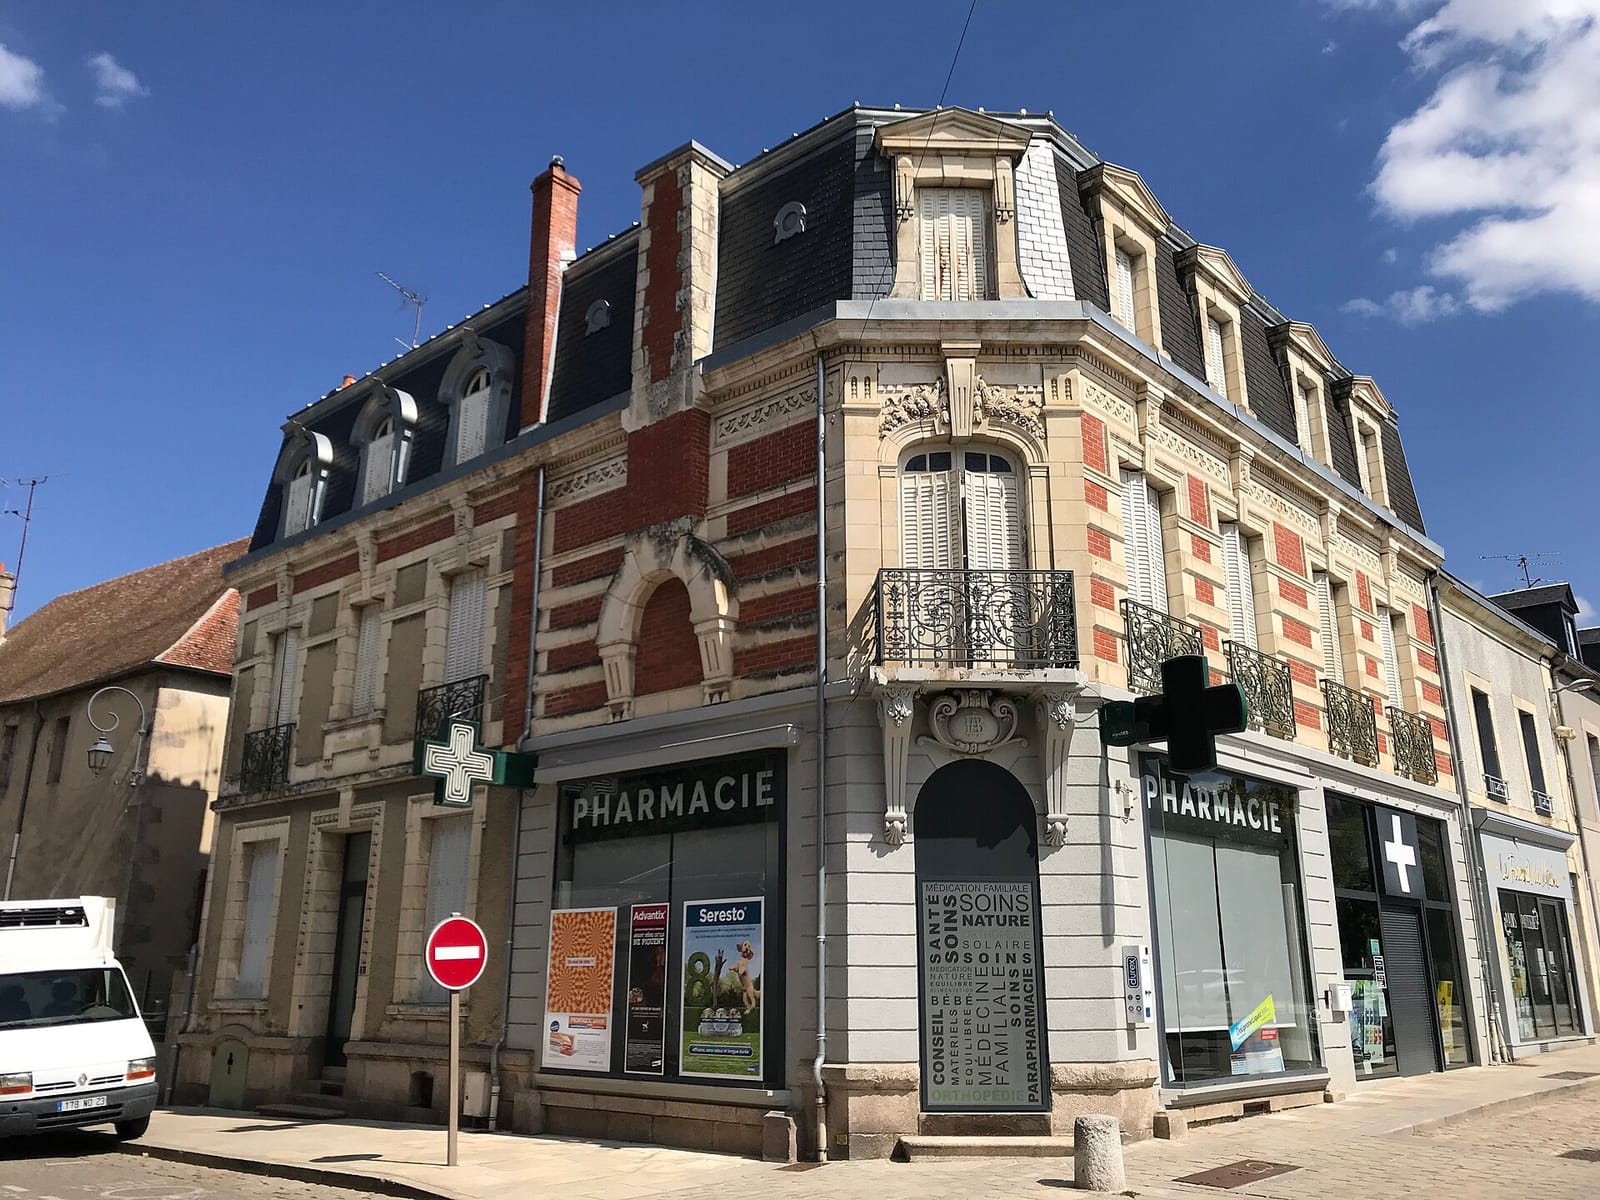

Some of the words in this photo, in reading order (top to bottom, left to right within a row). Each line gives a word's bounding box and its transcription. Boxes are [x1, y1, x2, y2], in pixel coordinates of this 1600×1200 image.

[573, 770, 774, 829] PHARMACIE
[1144, 774, 1281, 833] PHARMACIE
[633, 910, 666, 920] Advantix
[699, 907, 745, 922] Seresto
[960, 894, 1029, 912] SOINS
[984, 884, 1028, 892] FAMILIALE
[926, 895, 941, 964] SANTÉ
[943, 895, 959, 964] SOINS
[962, 914, 1030, 927] NATURE
[962, 941, 1030, 949] SOLAIRE
[963, 953, 1032, 964] SOINS
[1128, 958, 1137, 986] durex
[931, 993, 973, 1006] BÉBÉ
[974, 966, 992, 1085] MÉDECINE
[992, 966, 1009, 1085] FAMILIALE
[1009, 968, 1021, 1027] SOINS
[931, 1009, 945, 1085] CONSEIL
[949, 1009, 960, 1086] MATÉRIELS
[963, 1009, 974, 1086] EQUILIBRE
[1023, 968, 1039, 1103] PARAPHARMACIE
